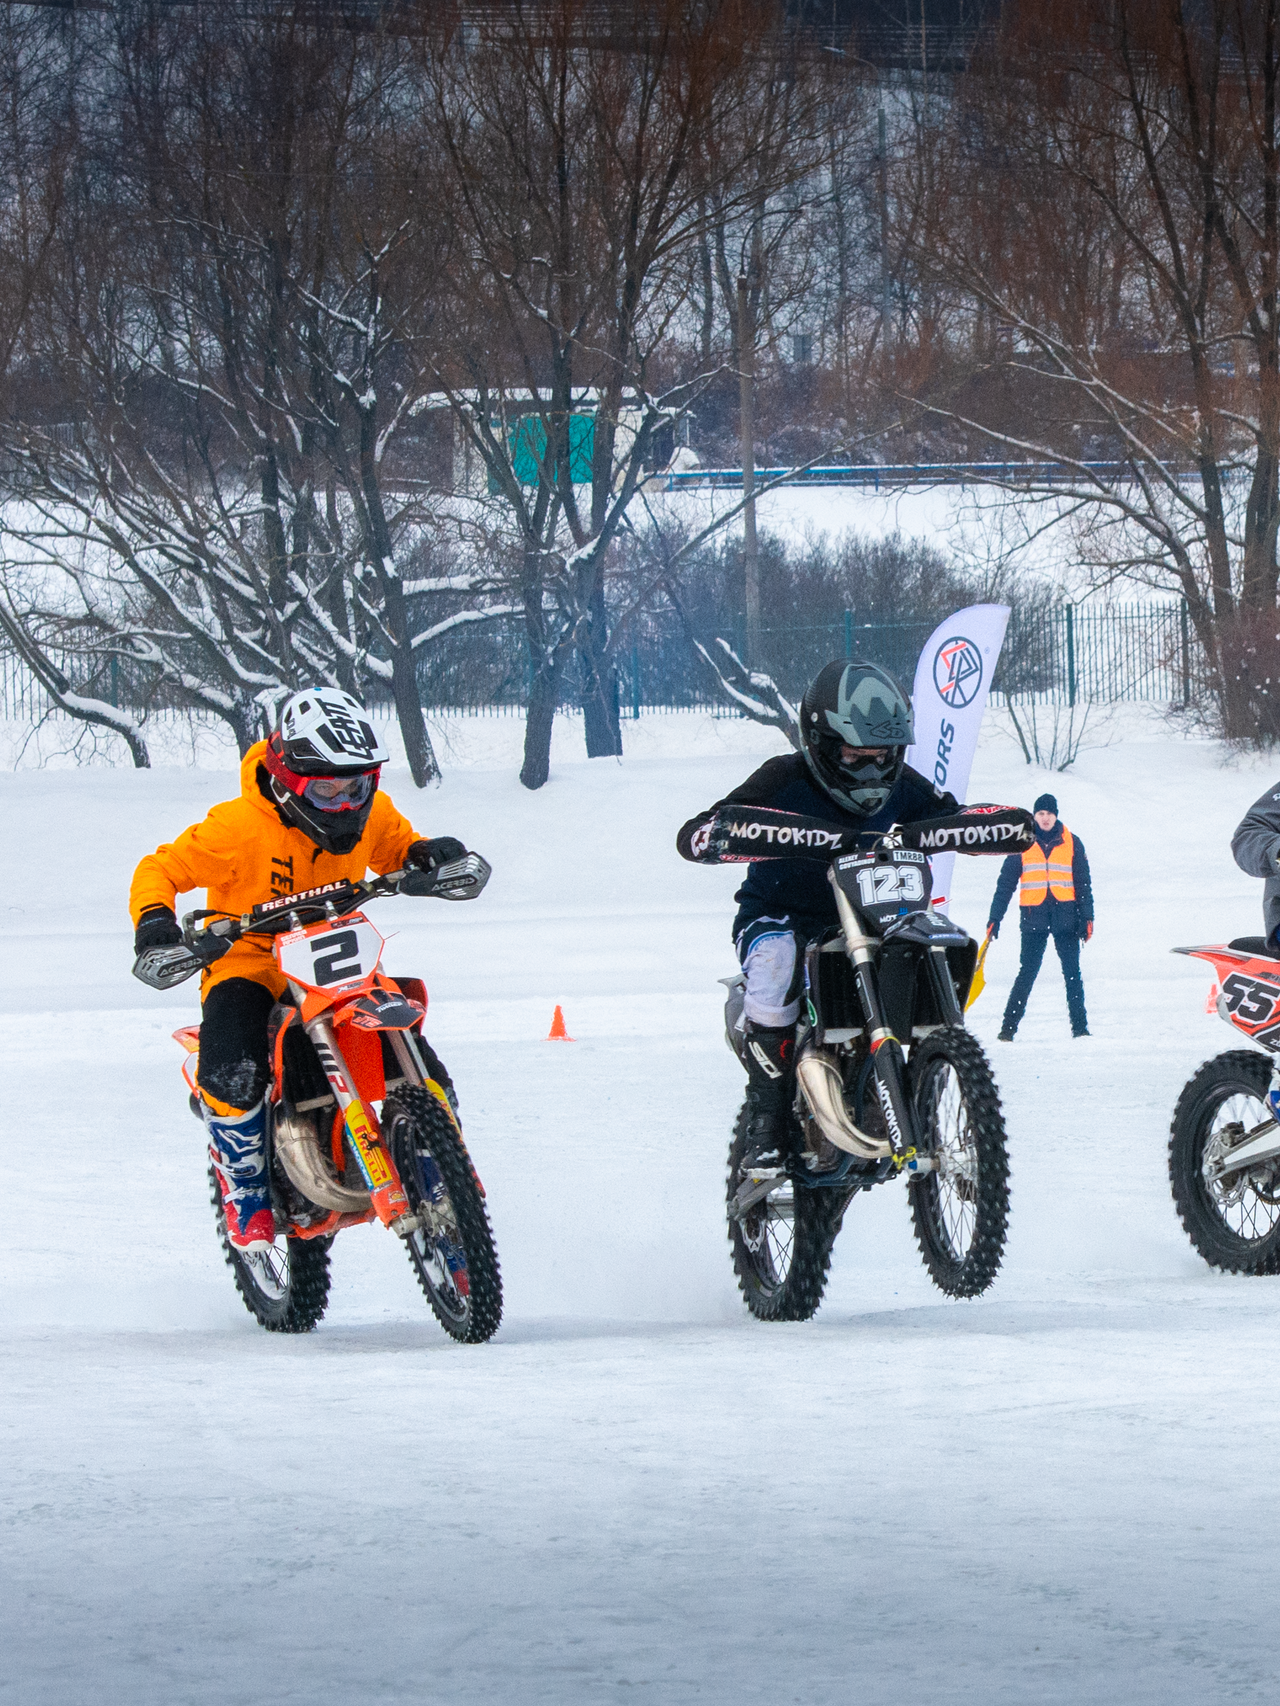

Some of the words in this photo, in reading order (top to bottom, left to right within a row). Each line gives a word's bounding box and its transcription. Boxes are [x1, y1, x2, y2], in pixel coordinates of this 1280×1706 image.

[933, 718, 955, 787] ORS
[730, 821, 843, 850] MOTOKIDZ
[919, 823, 1025, 848] MOTOKIDZ
[895, 851, 924, 863] TMR88
[261, 880, 348, 912] RENTHAL
[856, 865, 925, 906] 123
[310, 930, 362, 987] 2
[877, 1079, 904, 1152] MOTOKIDZ
